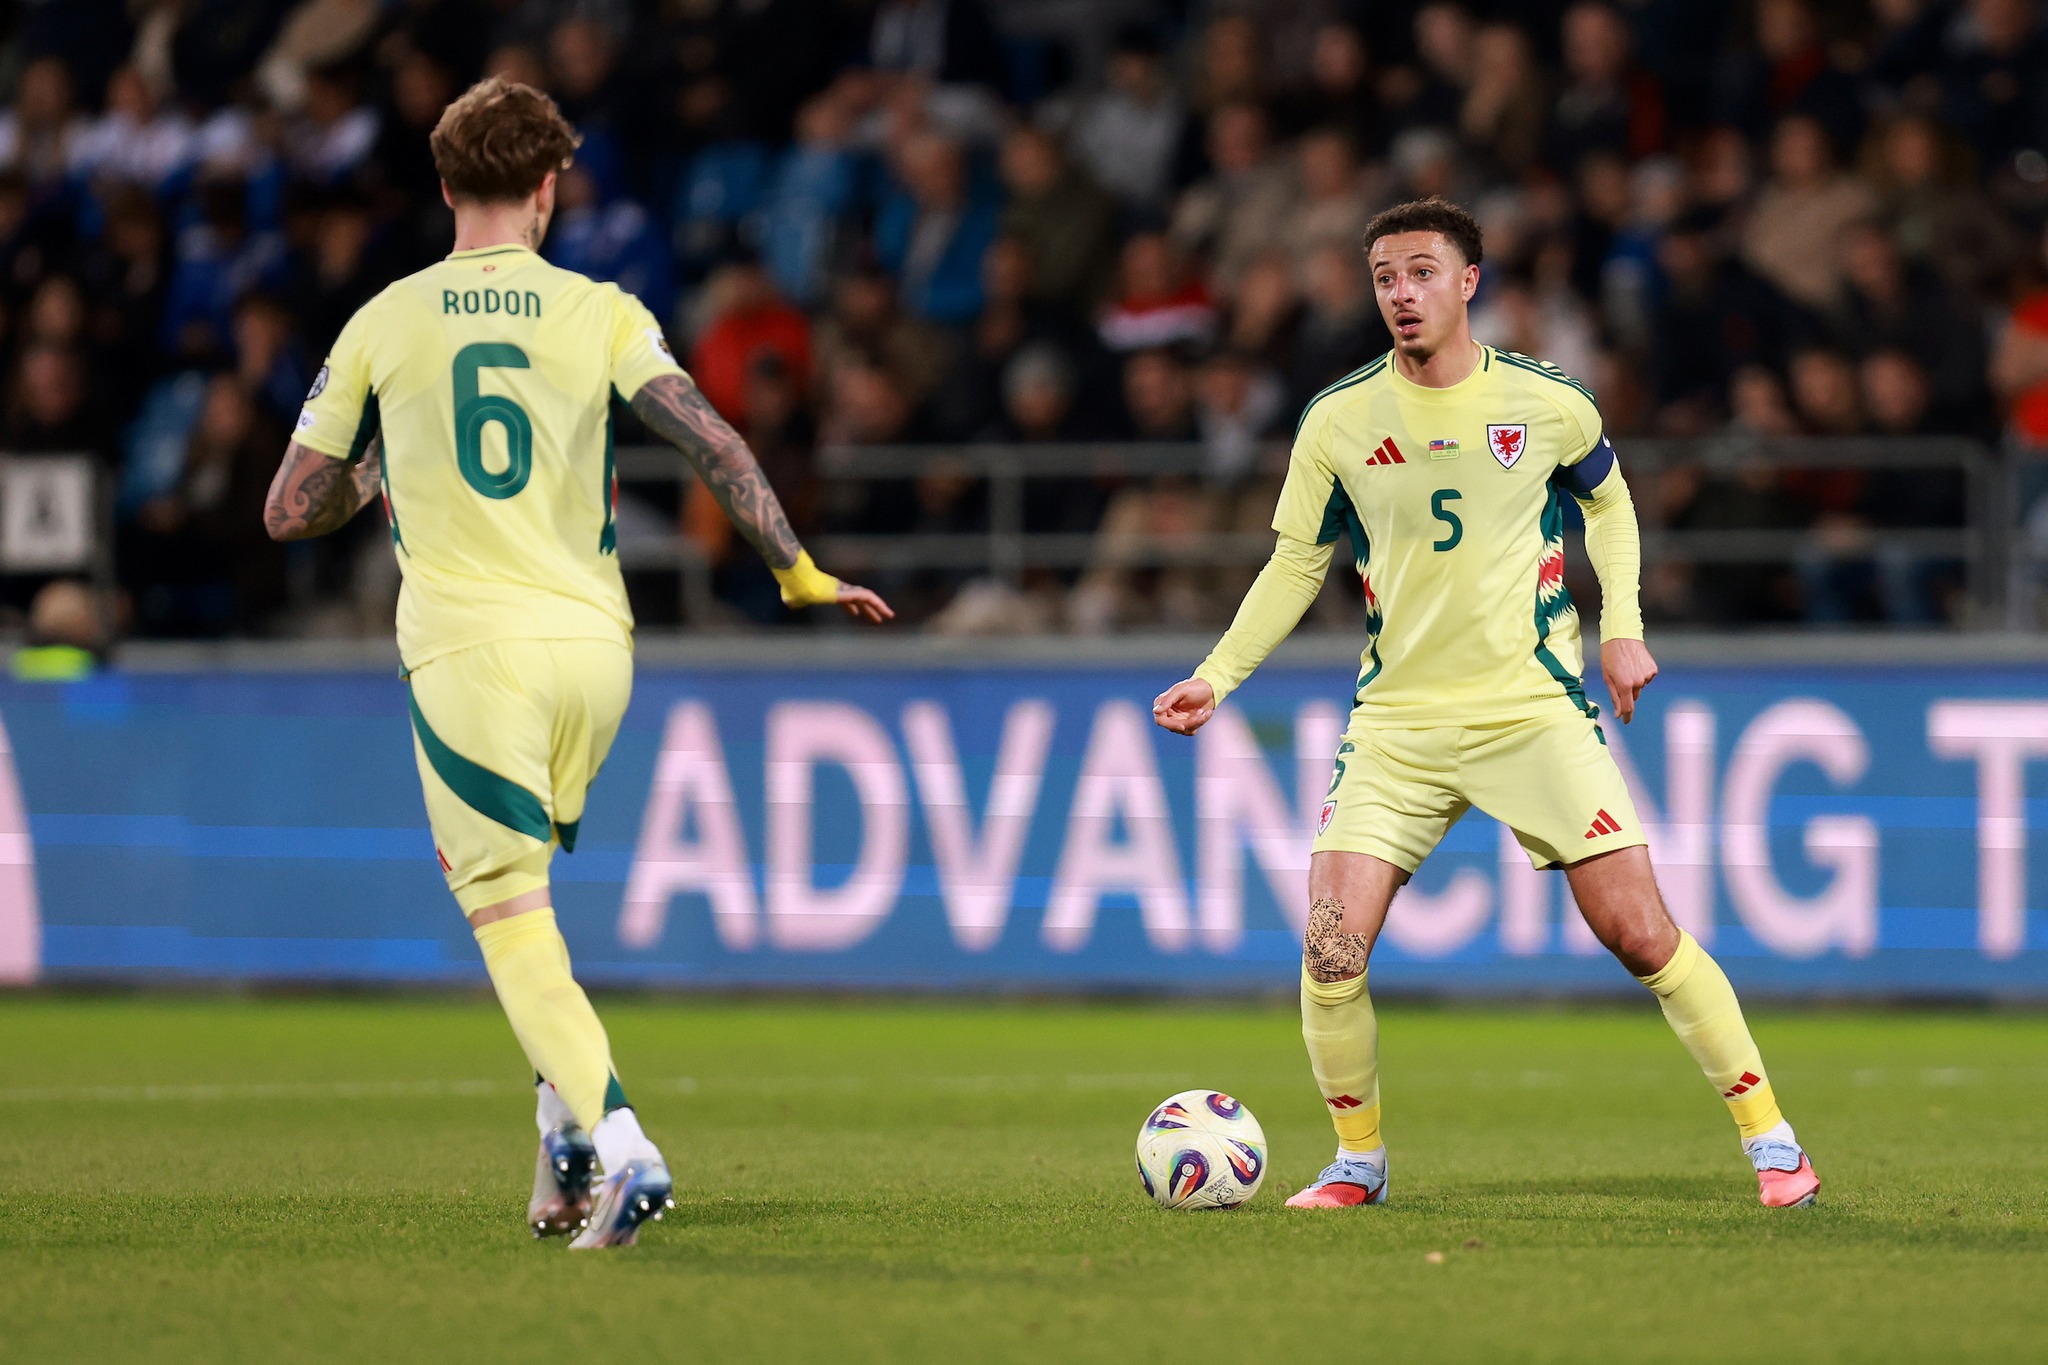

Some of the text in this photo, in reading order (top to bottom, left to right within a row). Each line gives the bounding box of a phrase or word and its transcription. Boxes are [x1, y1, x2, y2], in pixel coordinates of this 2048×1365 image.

[443, 289, 541, 317] RODON
[452, 341, 533, 500] 6
[1431, 488, 1463, 552] 5
